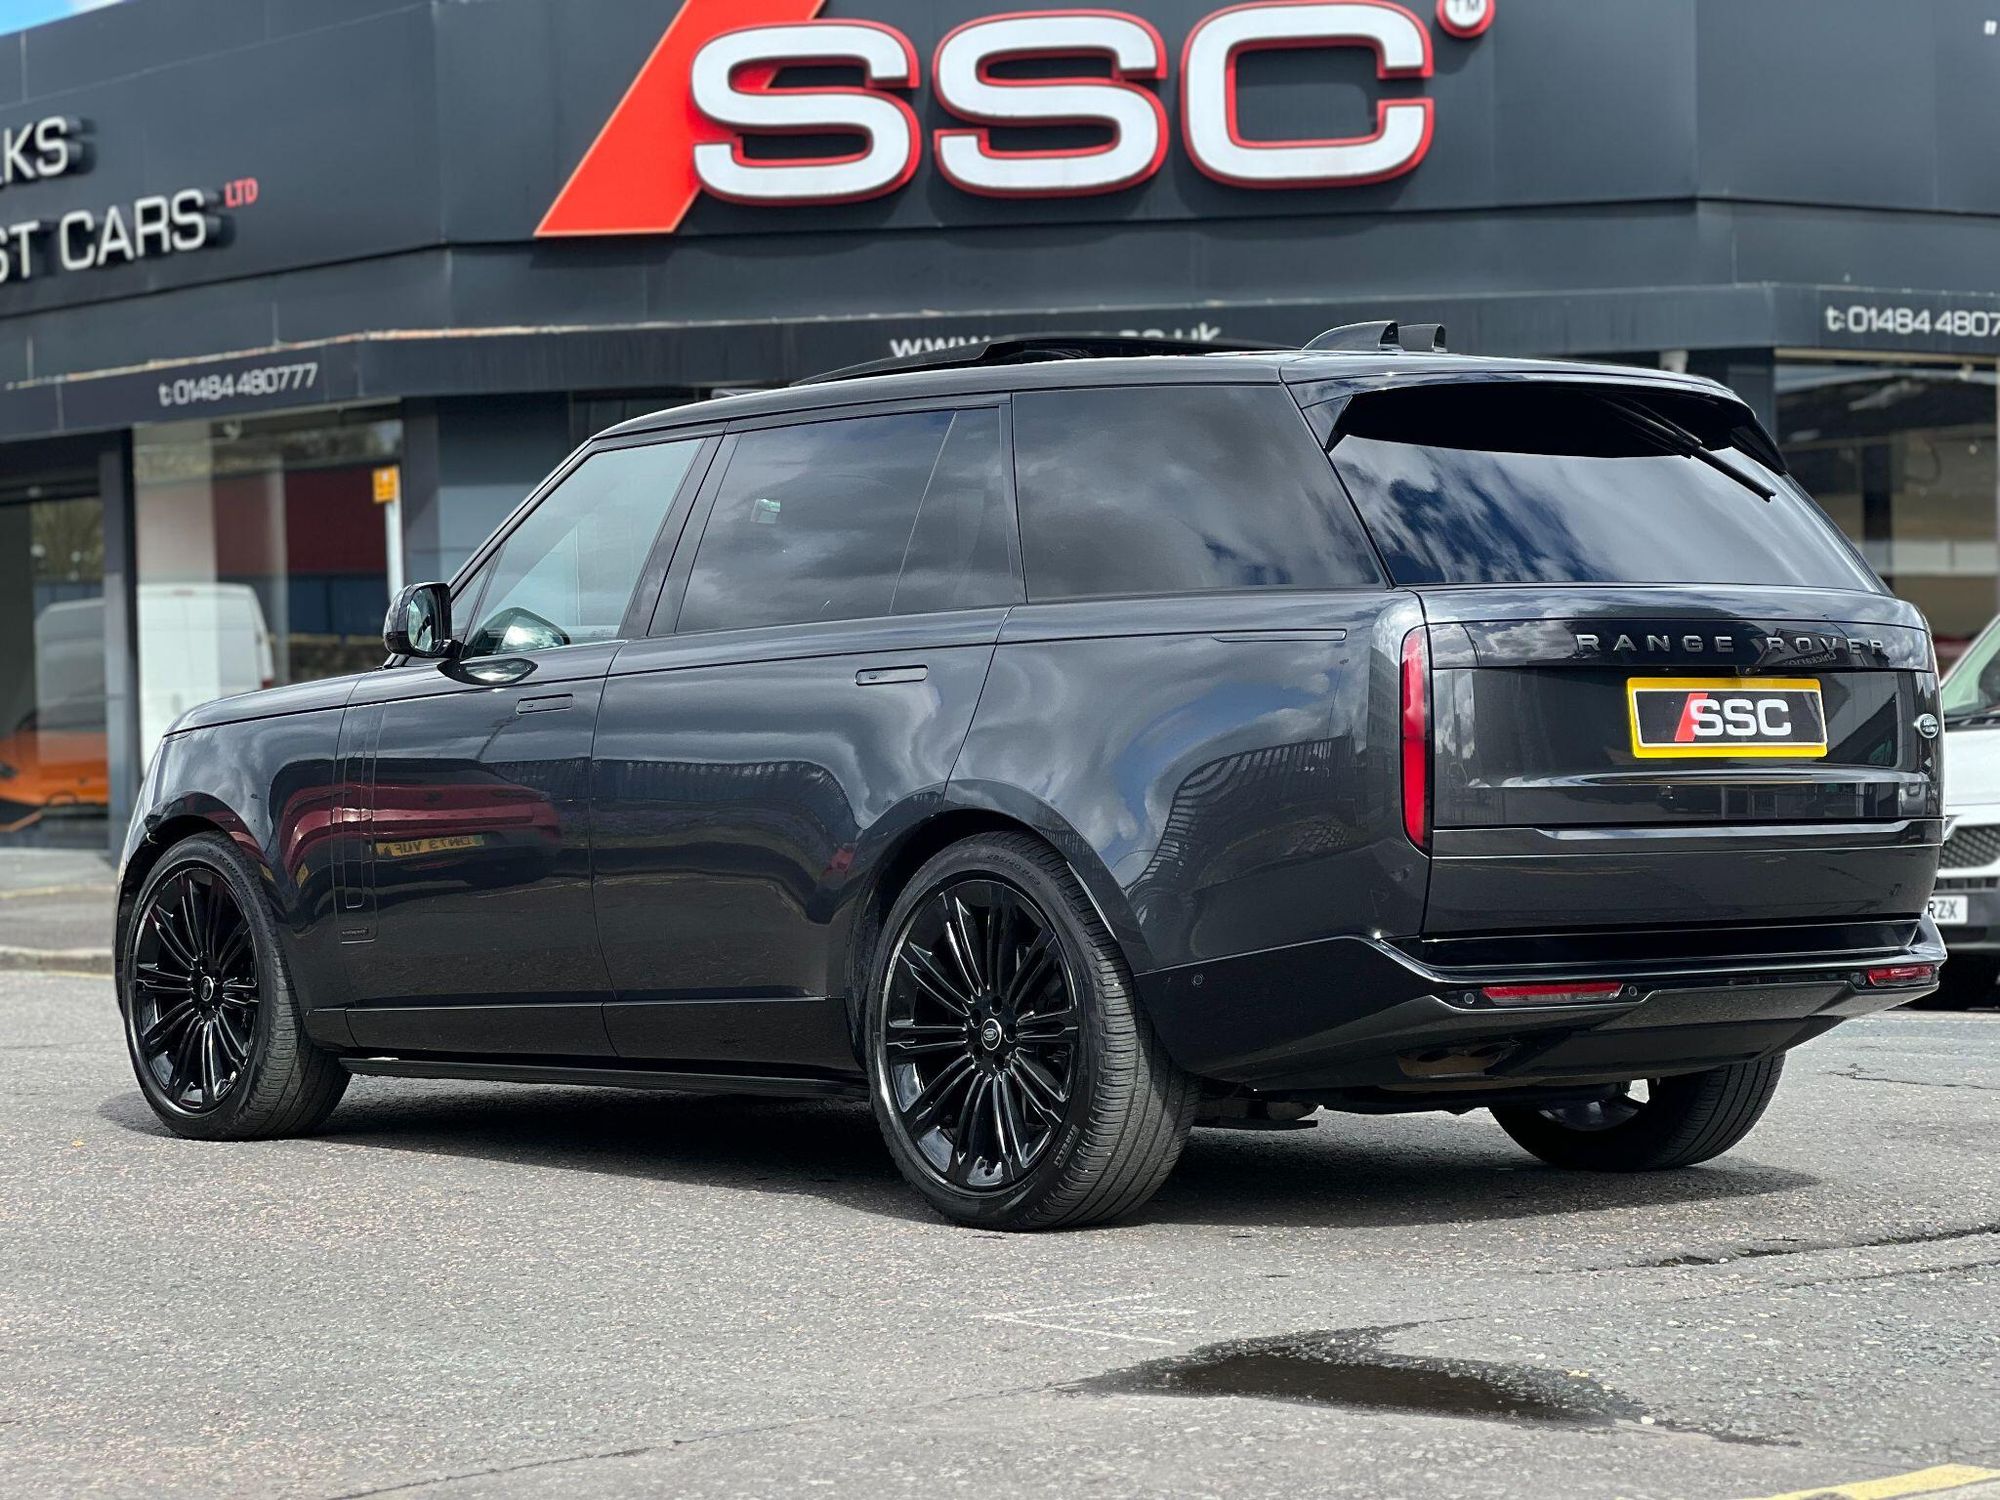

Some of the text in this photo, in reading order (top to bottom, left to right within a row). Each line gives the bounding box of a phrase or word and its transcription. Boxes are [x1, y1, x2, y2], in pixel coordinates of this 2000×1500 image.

[690, 1, 1435, 206] SSC
[59, 188, 206, 270] CARS
[225, 177, 259, 208] LTD
[1825, 304, 1931, 335] t:01484
[158, 361, 318, 407] t:01484 480777
[1576, 633, 1885, 656] RANGE ROVER
[1689, 698, 1793, 737] SSC
[1927, 900, 1957, 919] RZX
